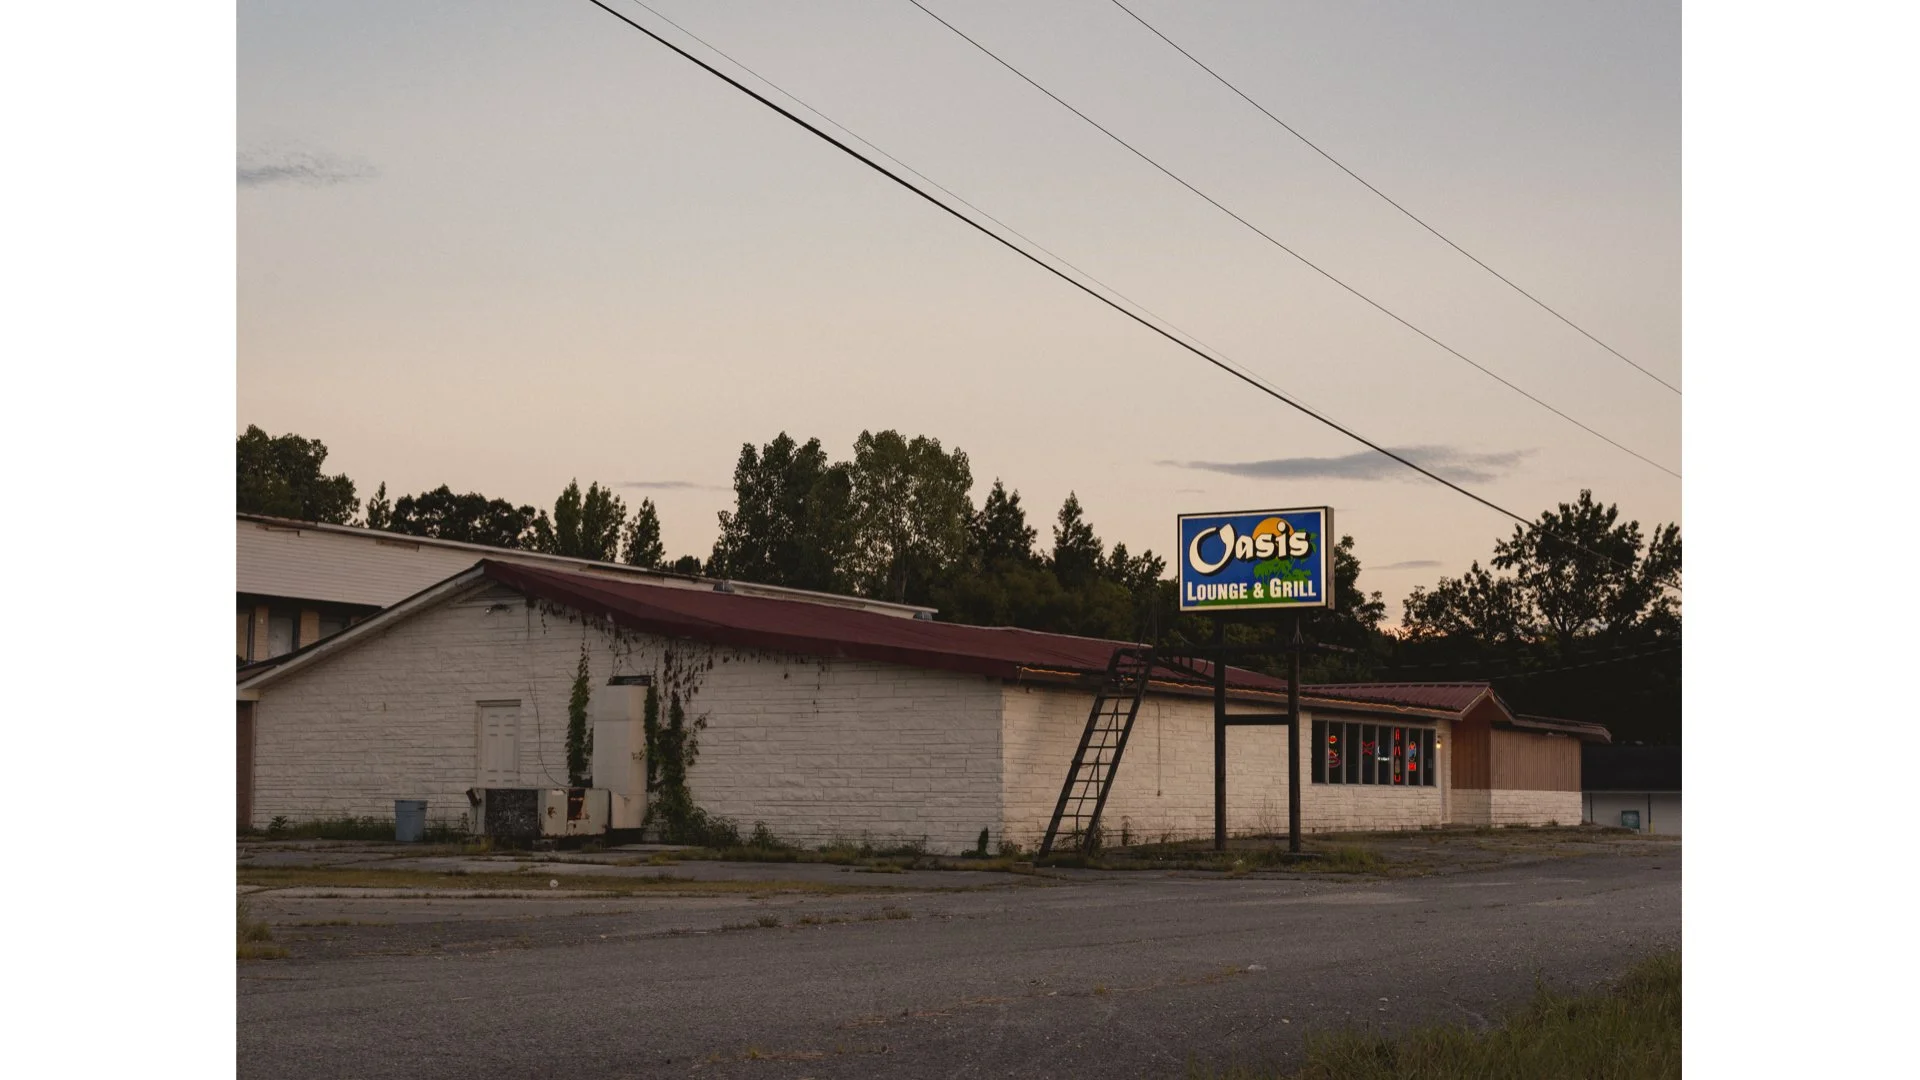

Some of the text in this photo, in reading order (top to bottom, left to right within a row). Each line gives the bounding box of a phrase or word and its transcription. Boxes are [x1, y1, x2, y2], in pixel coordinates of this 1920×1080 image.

[1189, 521, 1309, 574] Oasis
[1187, 577, 1317, 601] LOUNGE & GRILL
